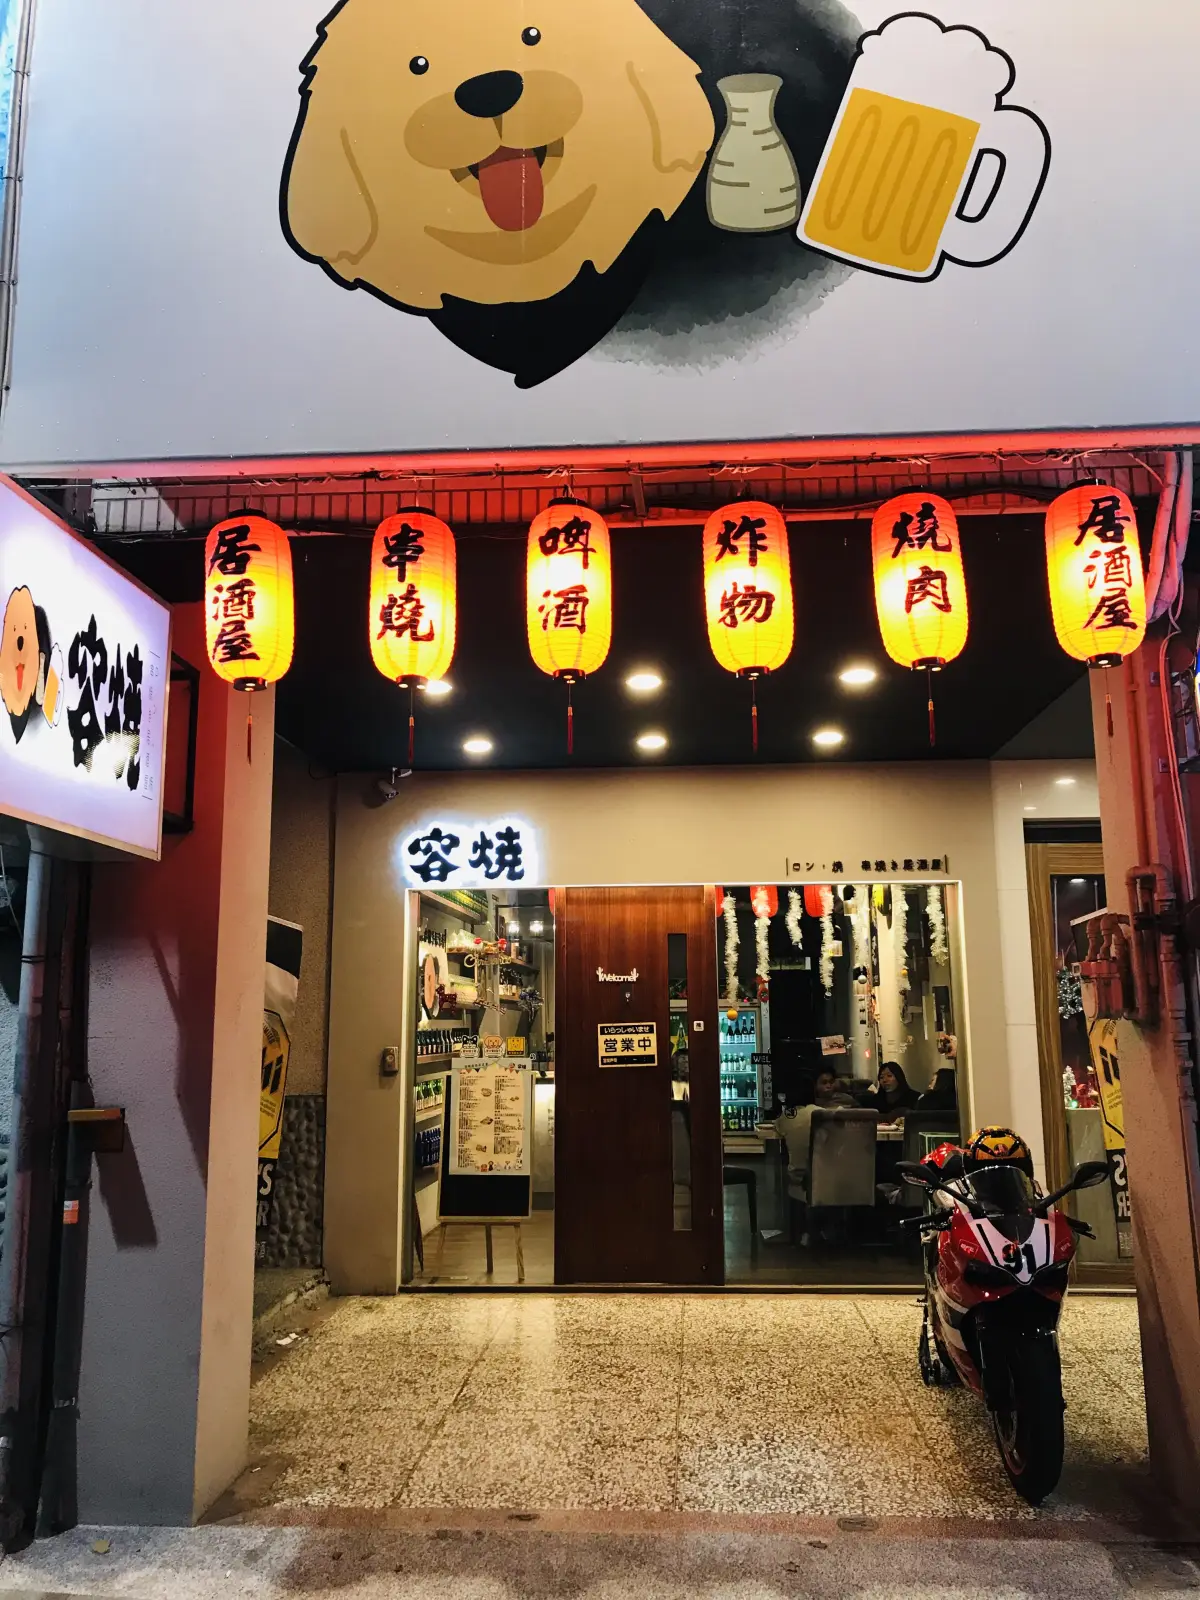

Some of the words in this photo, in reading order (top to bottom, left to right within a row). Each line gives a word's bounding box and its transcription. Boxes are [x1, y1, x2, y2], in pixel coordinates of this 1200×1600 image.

[208, 524, 262, 663] 居酒屋
[376, 522, 435, 642] 串燒
[538, 516, 597, 635] 啤酒
[715, 515, 776, 629] 炸物
[891, 501, 953, 614] 燒肉
[1073, 495, 1138, 630] 居酒屋
[604, 1026, 650, 1034] いらっしゃいませ
[604, 1037, 652, 1053] 営業中
[1002, 1243, 1037, 1275] 91
